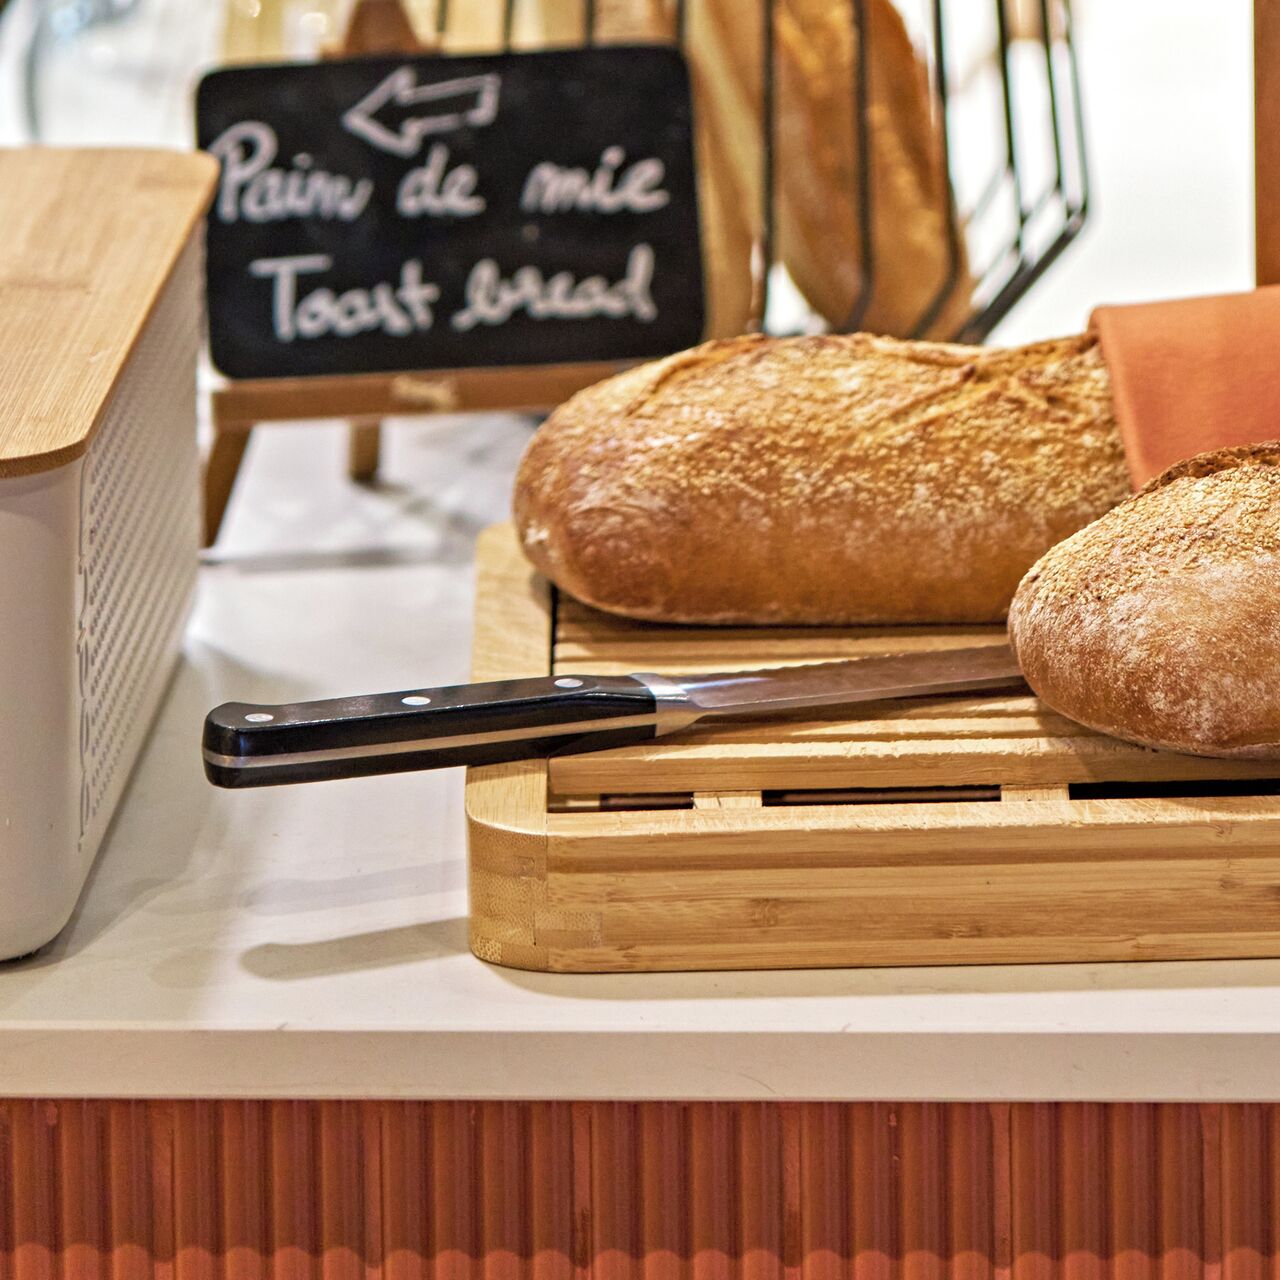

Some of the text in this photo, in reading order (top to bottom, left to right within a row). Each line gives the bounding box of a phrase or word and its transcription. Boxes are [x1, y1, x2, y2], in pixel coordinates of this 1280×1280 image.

[211, 120, 670, 223] Pain de mie
[248, 242, 658, 341] Toast bread
